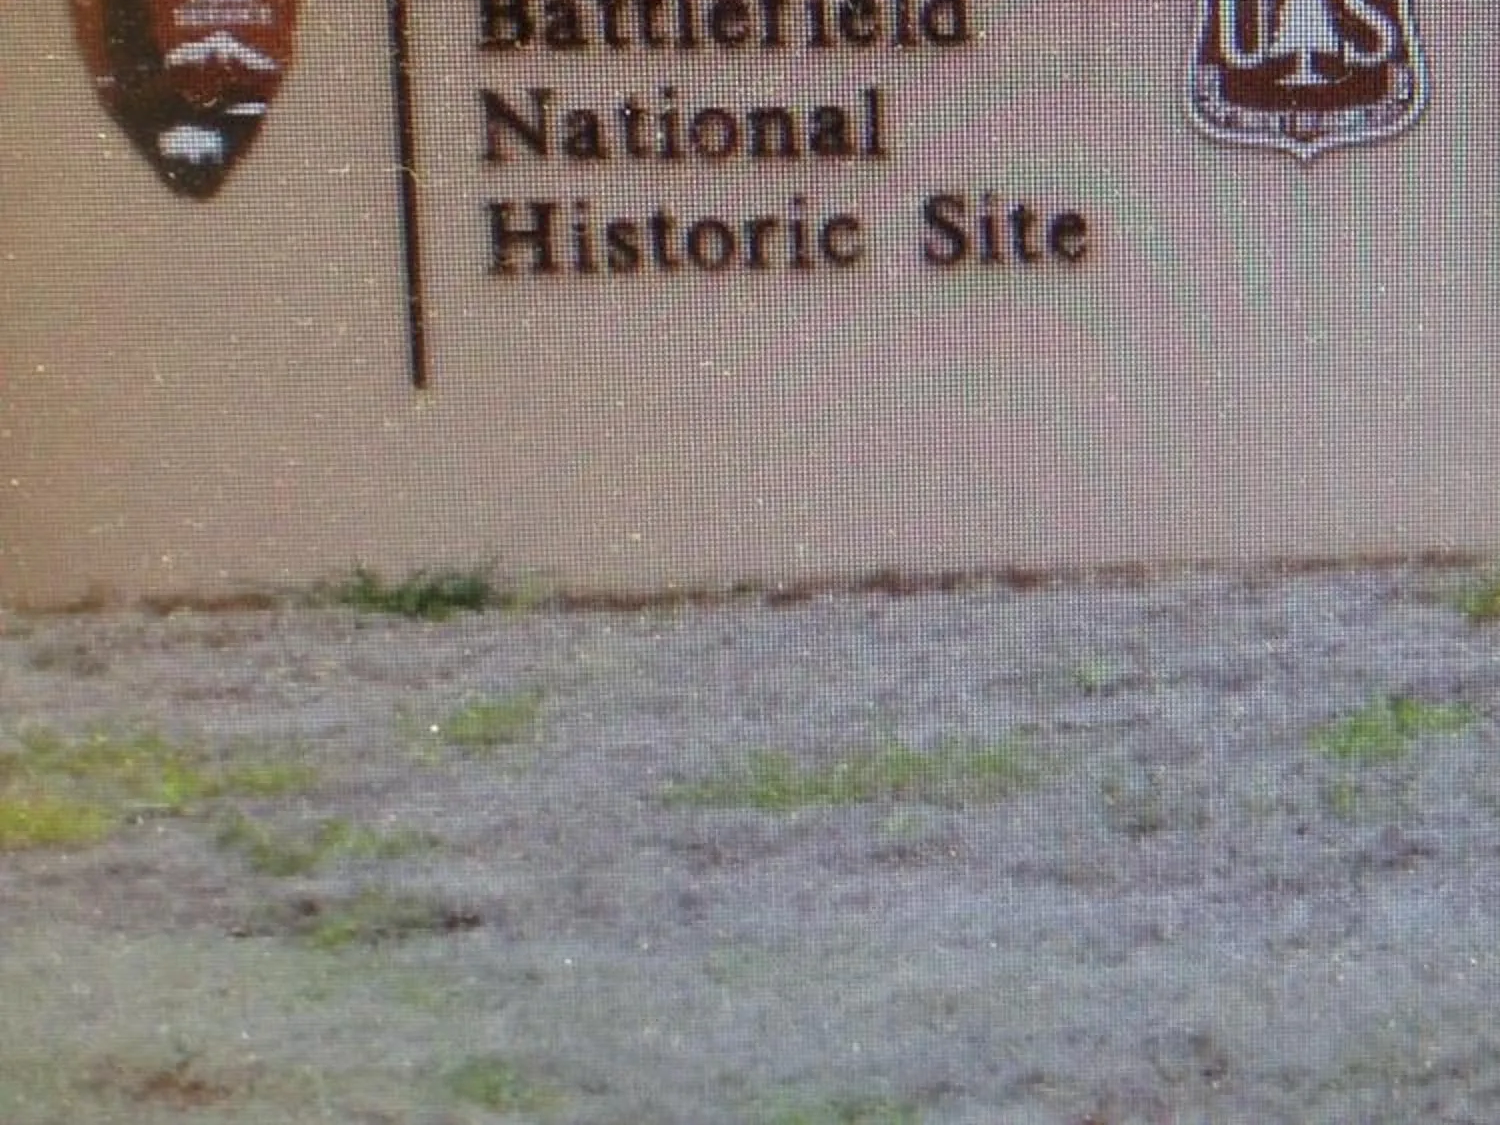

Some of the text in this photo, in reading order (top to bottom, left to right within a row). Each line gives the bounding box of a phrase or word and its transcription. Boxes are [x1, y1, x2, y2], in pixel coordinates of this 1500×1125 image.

[481, 87, 889, 162] National
[488, 189, 1089, 276] Historic Site
